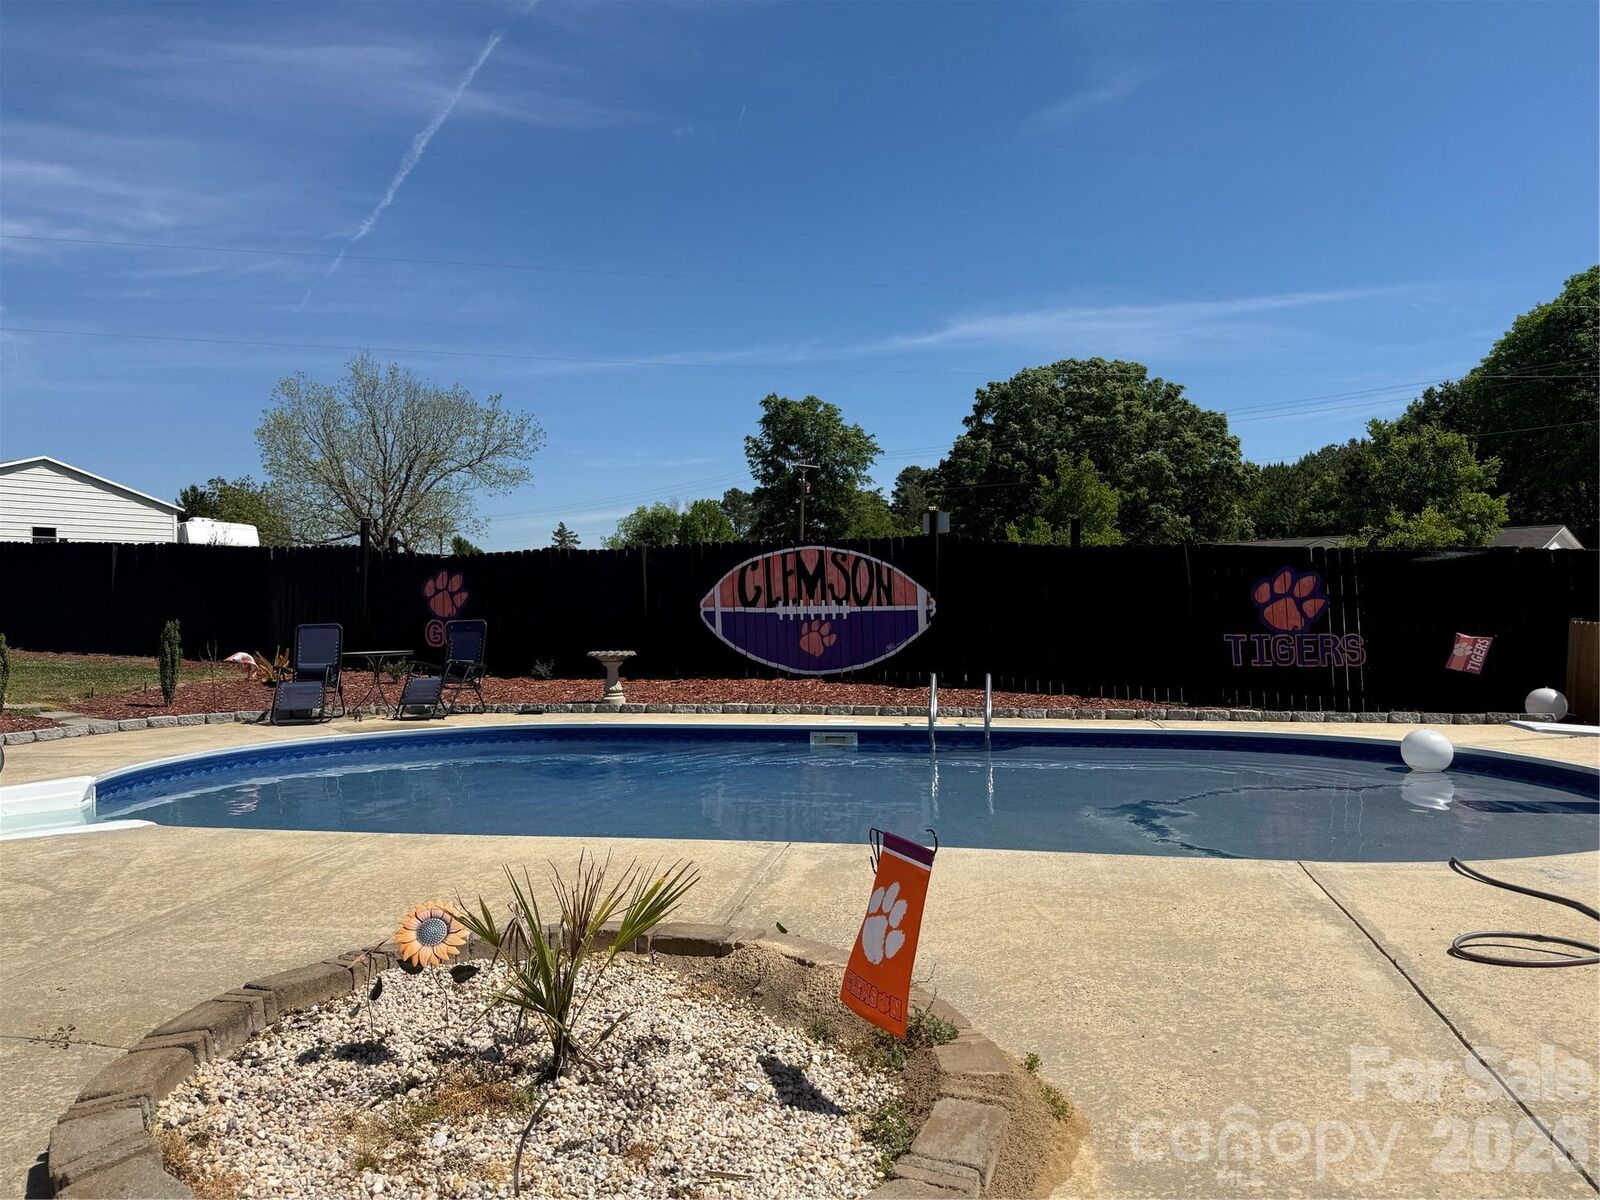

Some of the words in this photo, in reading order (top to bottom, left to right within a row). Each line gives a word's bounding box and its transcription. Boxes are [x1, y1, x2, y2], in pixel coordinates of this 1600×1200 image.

[738, 549, 894, 609] CLEMSON
[425, 619, 447, 647] G
[1223, 633, 1367, 667] TIGERS
[1466, 638, 1490, 671] TIGERS
